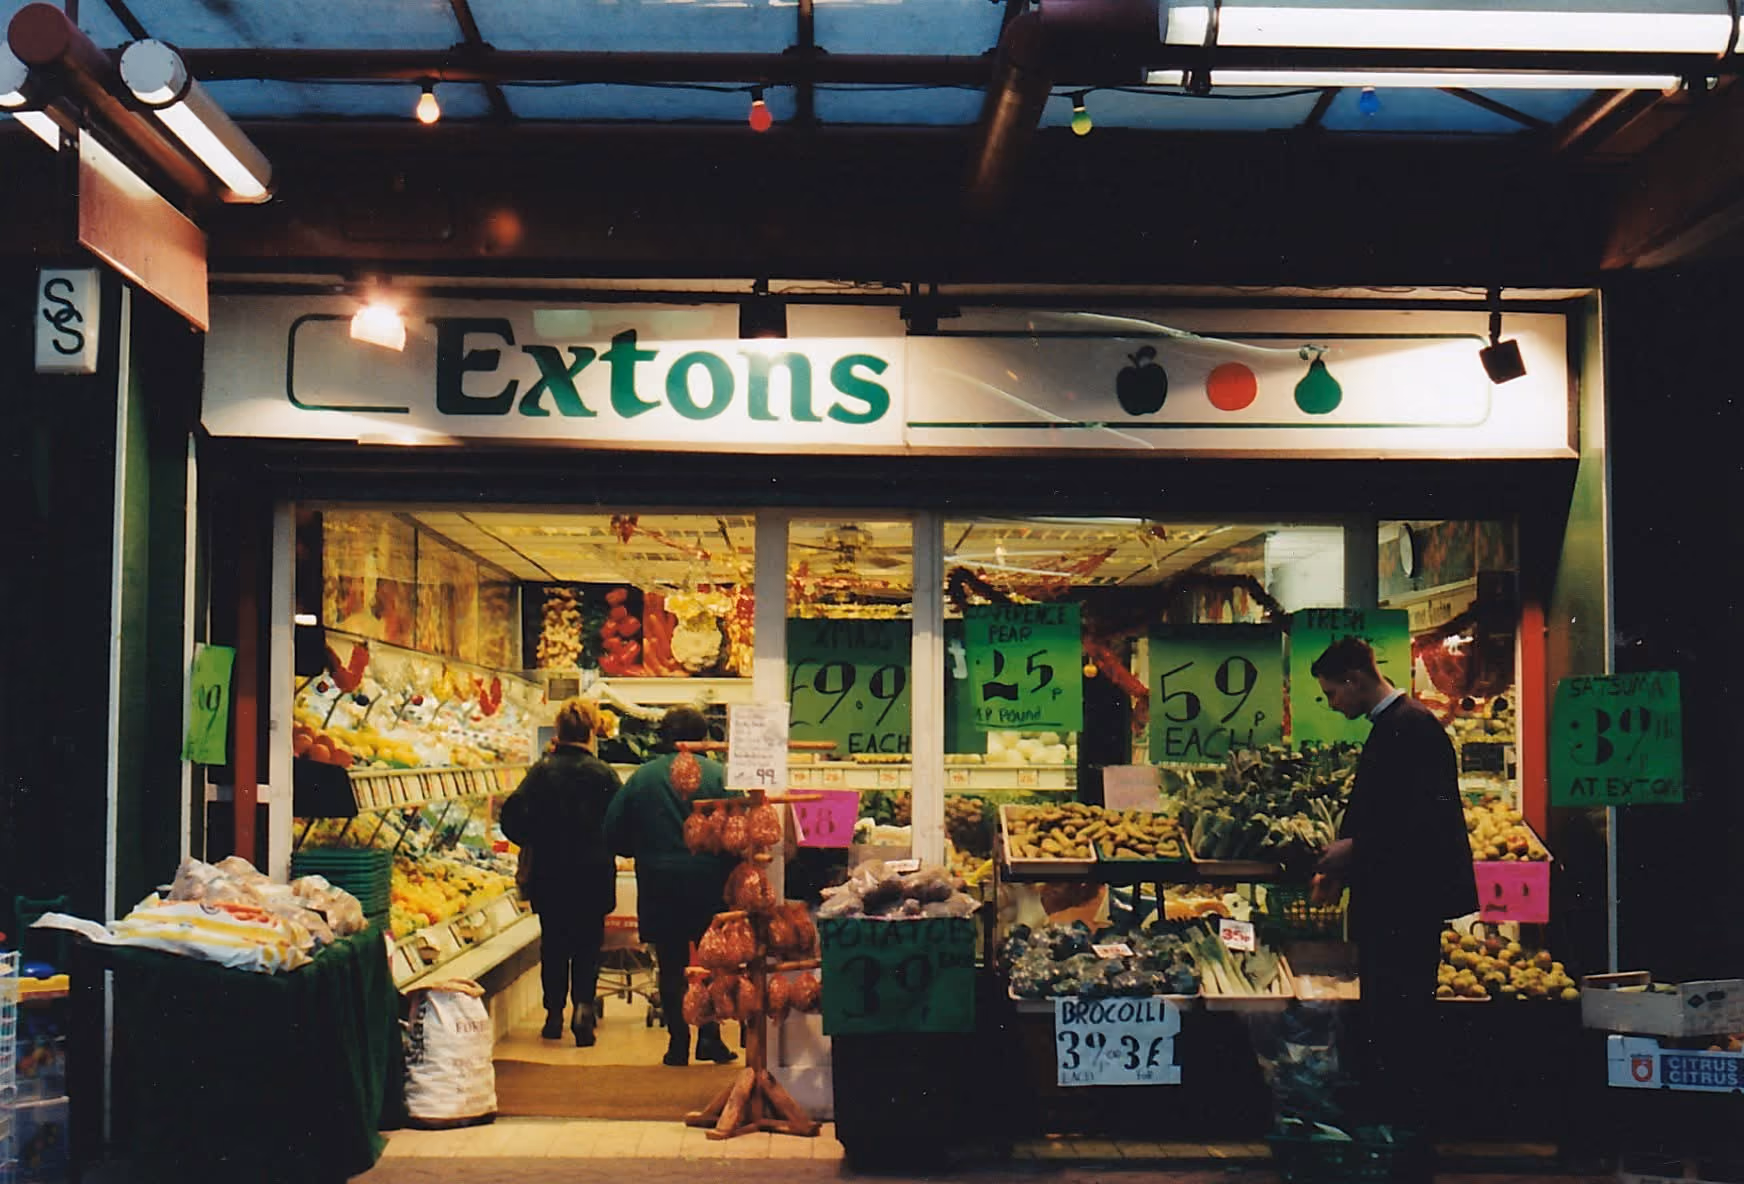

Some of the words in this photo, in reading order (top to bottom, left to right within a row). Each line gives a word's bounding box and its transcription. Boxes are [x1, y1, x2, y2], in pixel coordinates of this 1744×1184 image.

[426, 316, 891, 425] Extons
[847, 732, 912, 754] EACH
[1164, 726, 1255, 759] EACH
[1062, 1001, 1166, 1025] BROCOLLI
[1668, 1056, 1738, 1072] CITRUS
[1669, 1071, 1738, 1085] CITRUS
